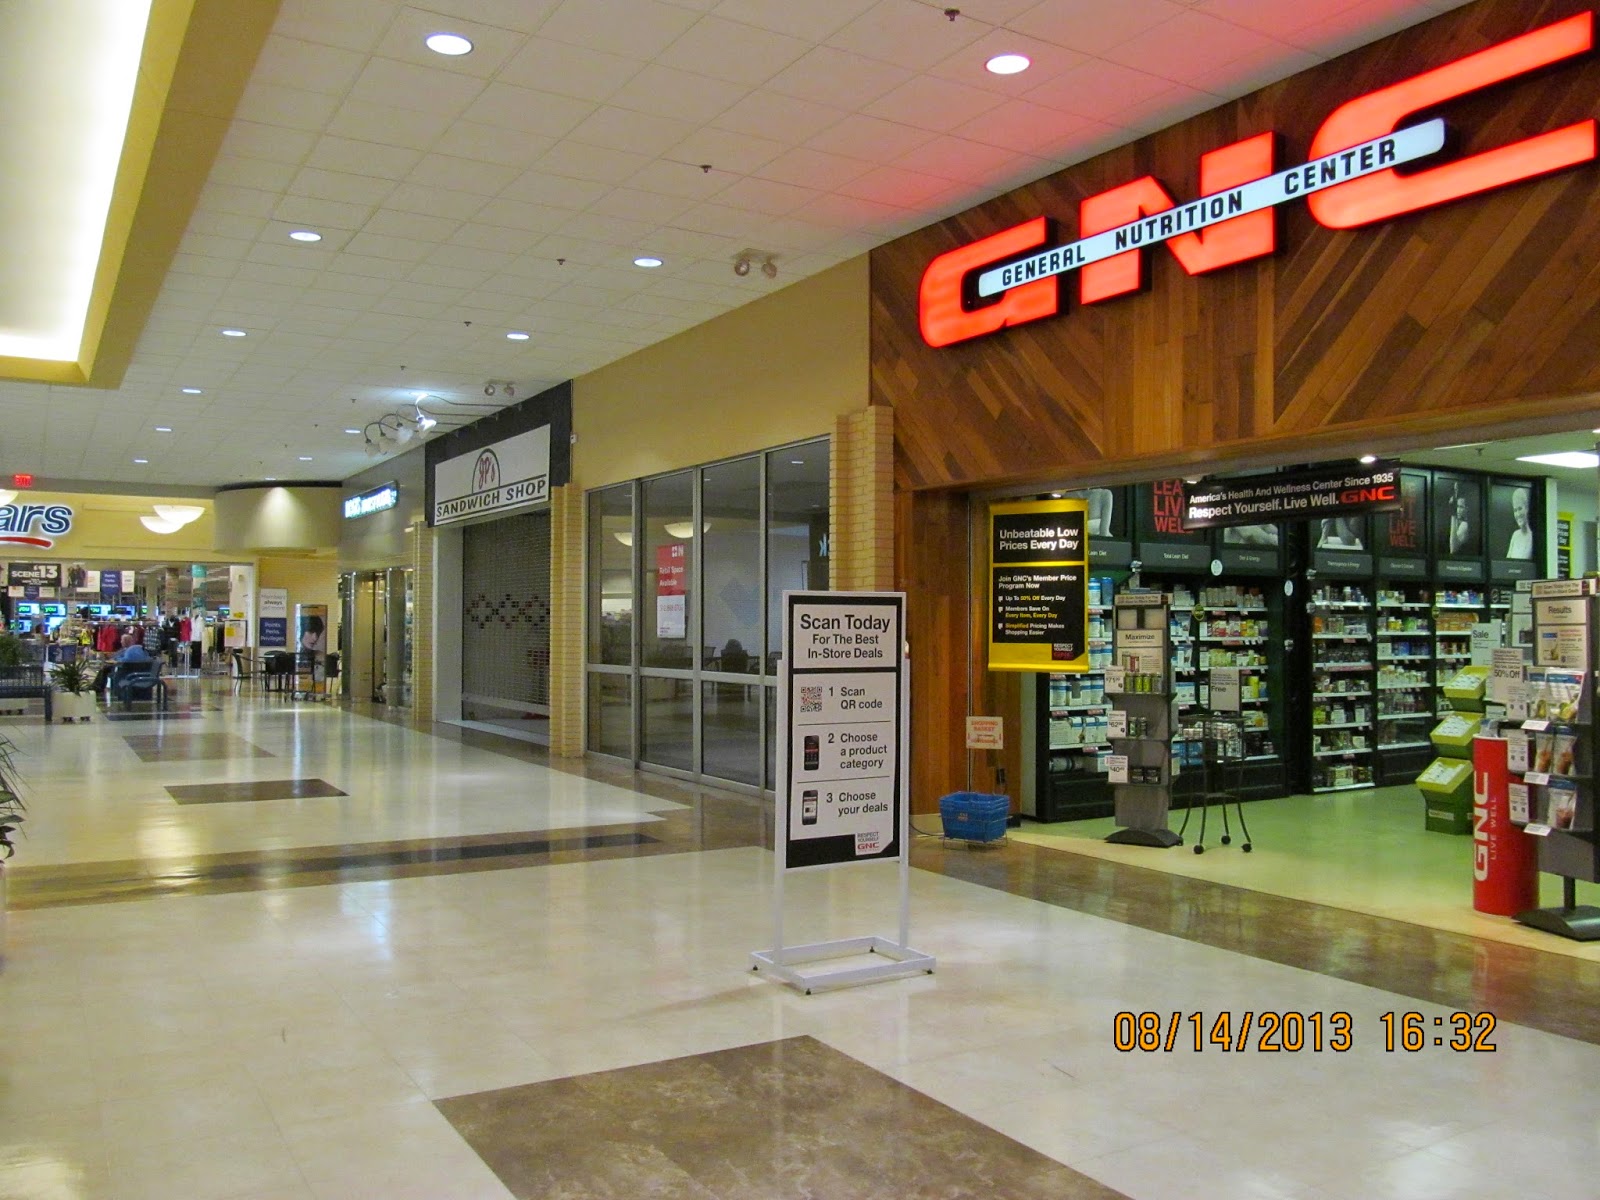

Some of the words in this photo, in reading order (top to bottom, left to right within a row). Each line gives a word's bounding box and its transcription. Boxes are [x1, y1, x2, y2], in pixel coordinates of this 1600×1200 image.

[919, 10, 1596, 348] GNC
[1001, 244, 1086, 287] GENERAL
[1114, 189, 1244, 252] NUTRITION
[1283, 138, 1397, 196] CENTER
[1153, 479, 1184, 496] LEA
[1189, 491, 1227, 504] America's
[1228, 489, 1254, 501] Health
[1255, 487, 1272, 497] And
[1273, 482, 1311, 496] Wellness
[1312, 479, 1343, 491] Center
[1344, 475, 1370, 487] Since
[1371, 472, 1394, 484] 1935
[436, 490, 500, 518] SANDWICH
[505, 479, 546, 501] SHOP
[1188, 503, 1232, 519] Respect
[1233, 499, 1282, 514] Yourself.
[1283, 495, 1308, 510] Live
[1309, 492, 1339, 507] Well.
[1340, 485, 1395, 504] GNC
[1153, 495, 1185, 517] LIV
[999, 527, 1055, 539] Unbeatable
[1056, 526, 1079, 538] Low
[999, 540, 1028, 551] Prices
[1030, 539, 1057, 551] Every
[1058, 538, 1079, 550] Day
[11, 570, 40, 578] SCENE
[1548, 606, 1572, 614] Results
[800, 614, 841, 630] Scan
[844, 614, 891, 633] Today
[812, 634, 830, 645] For
[832, 634, 850, 645] The
[851, 634, 879, 645] Best
[1472, 630, 1489, 639] Sale
[807, 648, 851, 659] In-Store
[854, 648, 883, 659] Deals
[1494, 669, 1509, 678] 50%
[1509, 670, 1521, 679] Off
[828, 687, 834, 697] 1
[840, 687, 866, 697] Scan
[1211, 685, 1227, 693] Free
[840, 700, 856, 711] QR
[858, 698, 883, 709] code
[827, 733, 835, 744] 2
[840, 732, 878, 743] Choose
[840, 747, 846, 756] a
[849, 744, 887, 757] product
[840, 758, 884, 770] category
[826, 792, 833, 803] 3
[838, 791, 876, 803] Choose
[838, 805, 859, 817] your
[862, 802, 888, 814] deals
[1474, 770, 1489, 882] GNC
[857, 842, 880, 850] GNC
